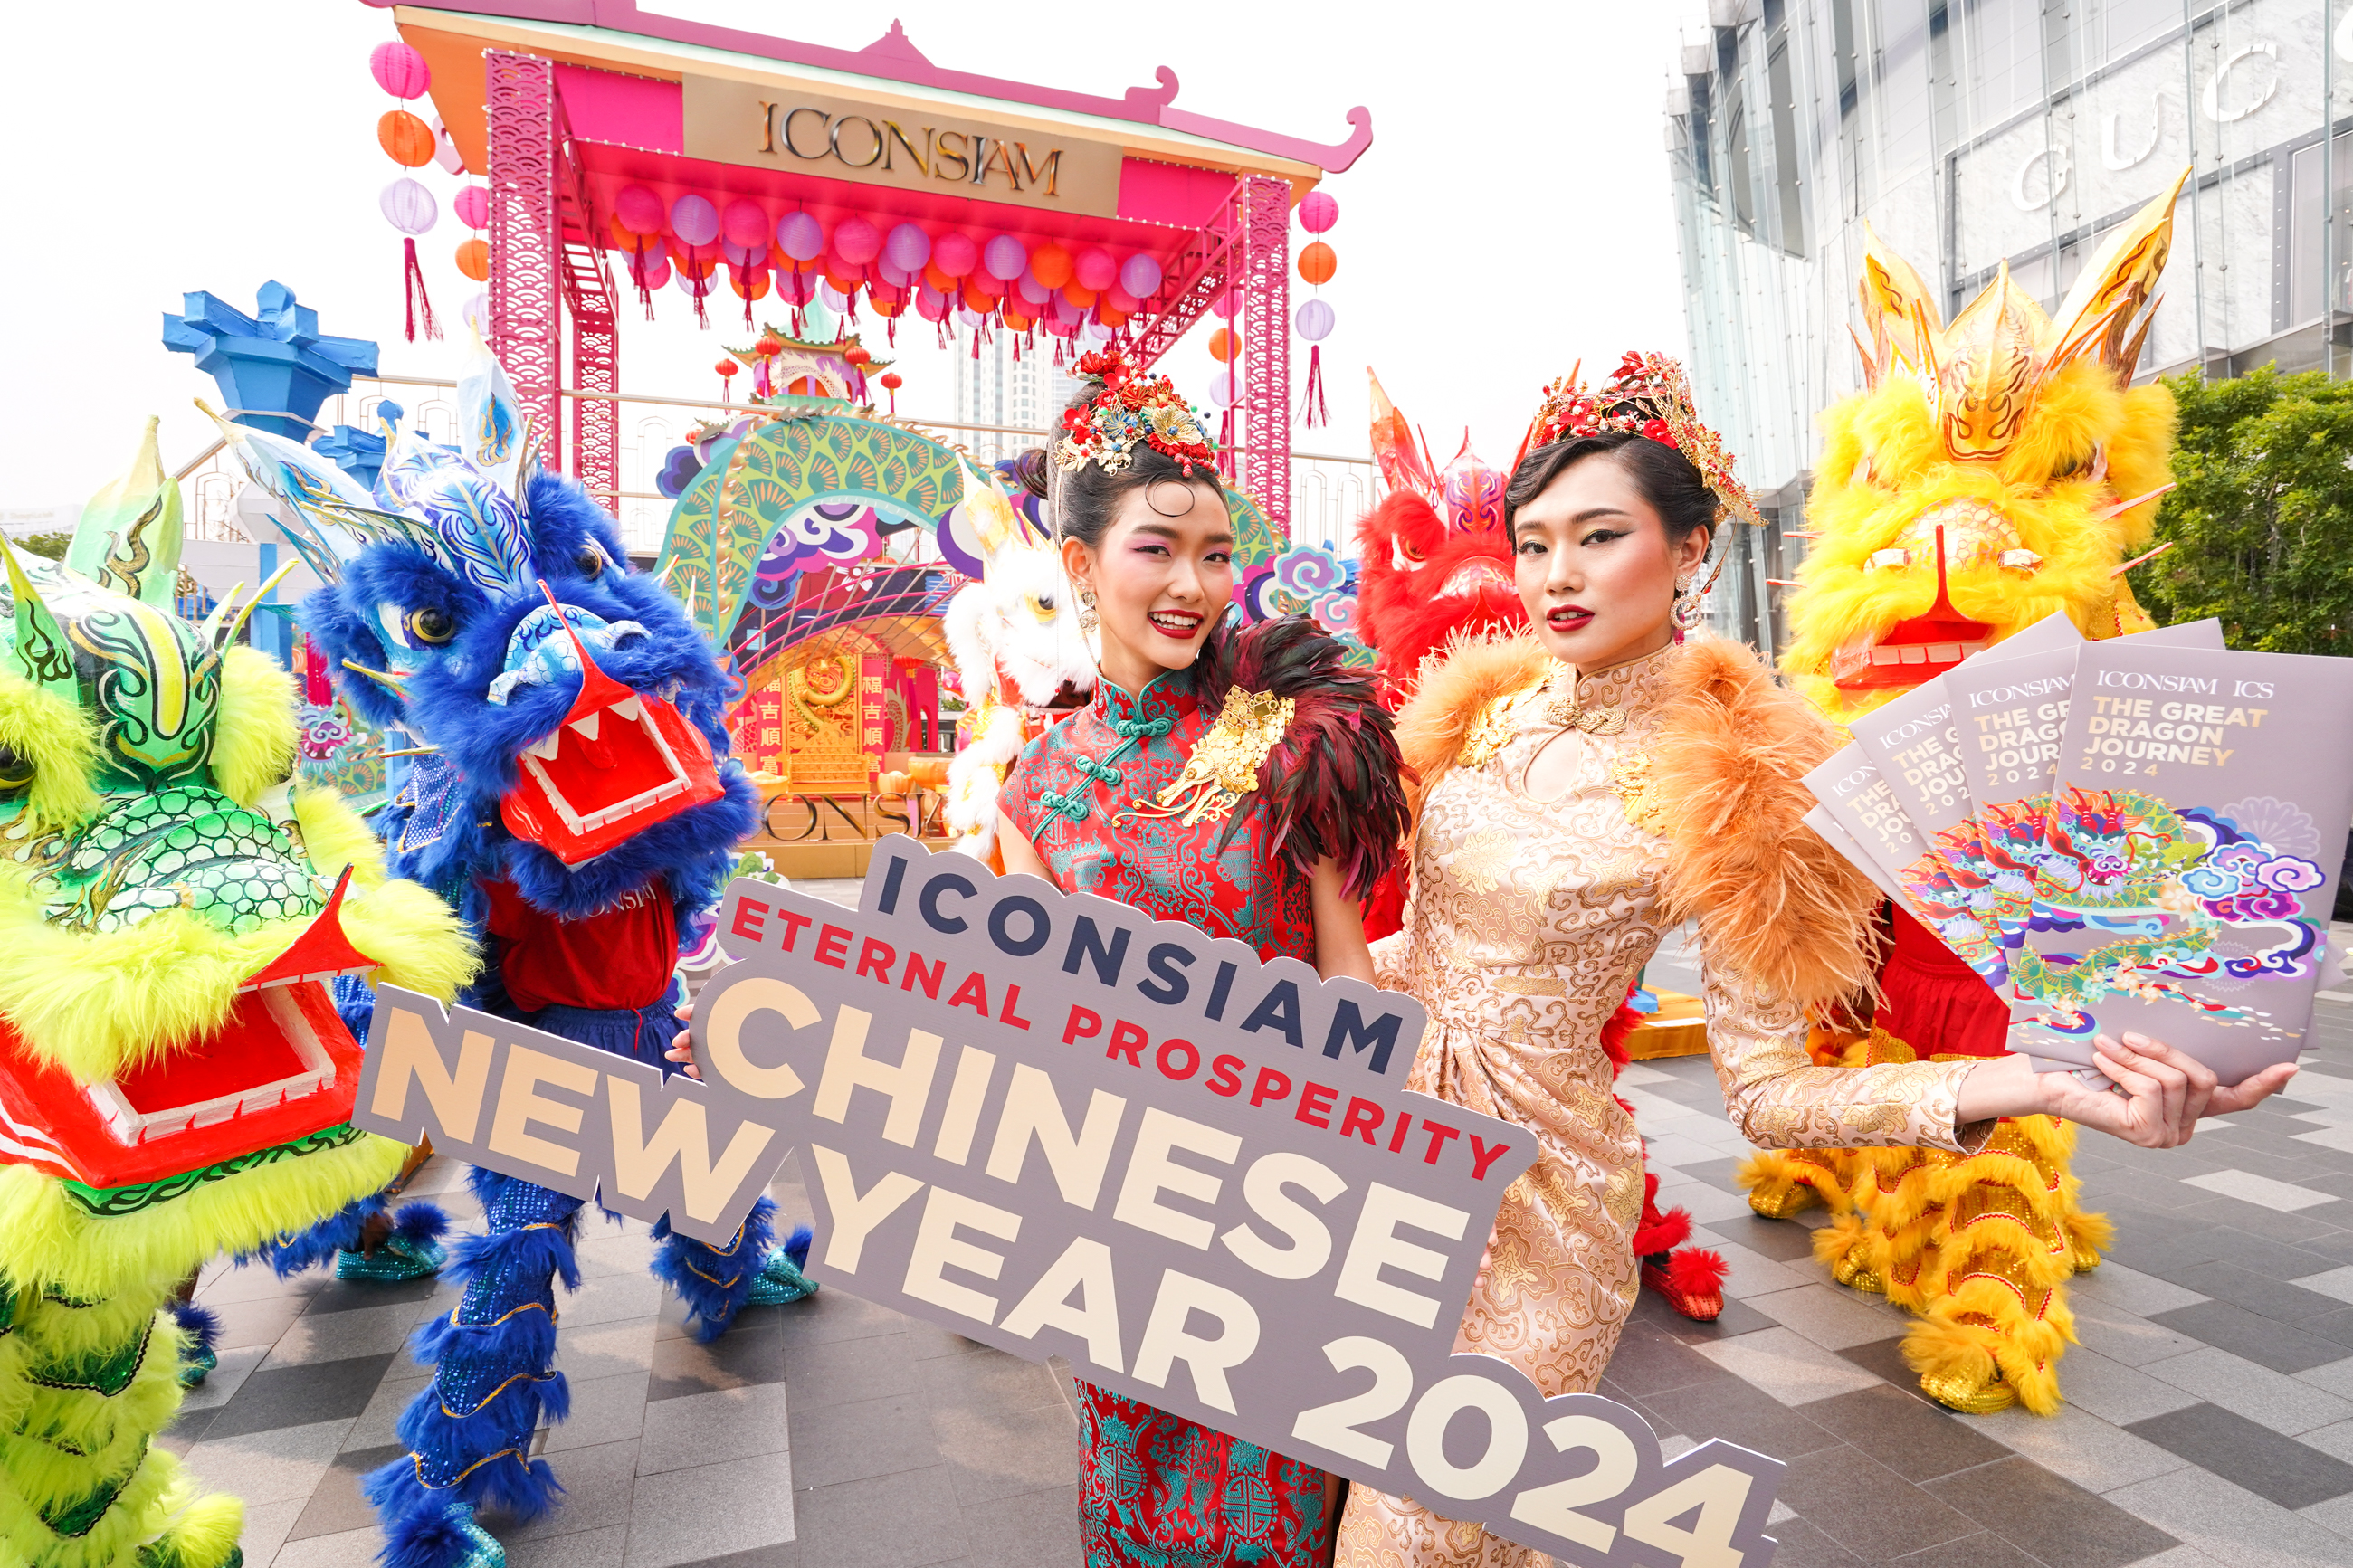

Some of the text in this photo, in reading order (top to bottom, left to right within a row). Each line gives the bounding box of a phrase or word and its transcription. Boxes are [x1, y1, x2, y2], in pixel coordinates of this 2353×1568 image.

[2011, 5, 2353, 212] GUC
[758, 100, 1064, 197] ICONSIAM
[2096, 670, 2274, 699] ICONSIAM ICS
[1974, 708, 2031, 732] THE
[2093, 696, 2268, 727] THE GREAT
[2088, 716, 2224, 745] DRAGON
[1891, 736, 1943, 769] THE
[1985, 742, 2062, 770] JOUR
[2080, 756, 2158, 777] 2024
[2083, 736, 2234, 766] JOURNEY
[1846, 779, 1891, 813] THE
[1920, 765, 1966, 802] JOU
[878, 855, 1404, 1075] ICONSIAM
[731, 896, 1511, 1181] ETERNAL PROSPERITY
[706, 977, 1471, 1330] CHINESE
[371, 1006, 1754, 1568] NEW YEAR 2024
